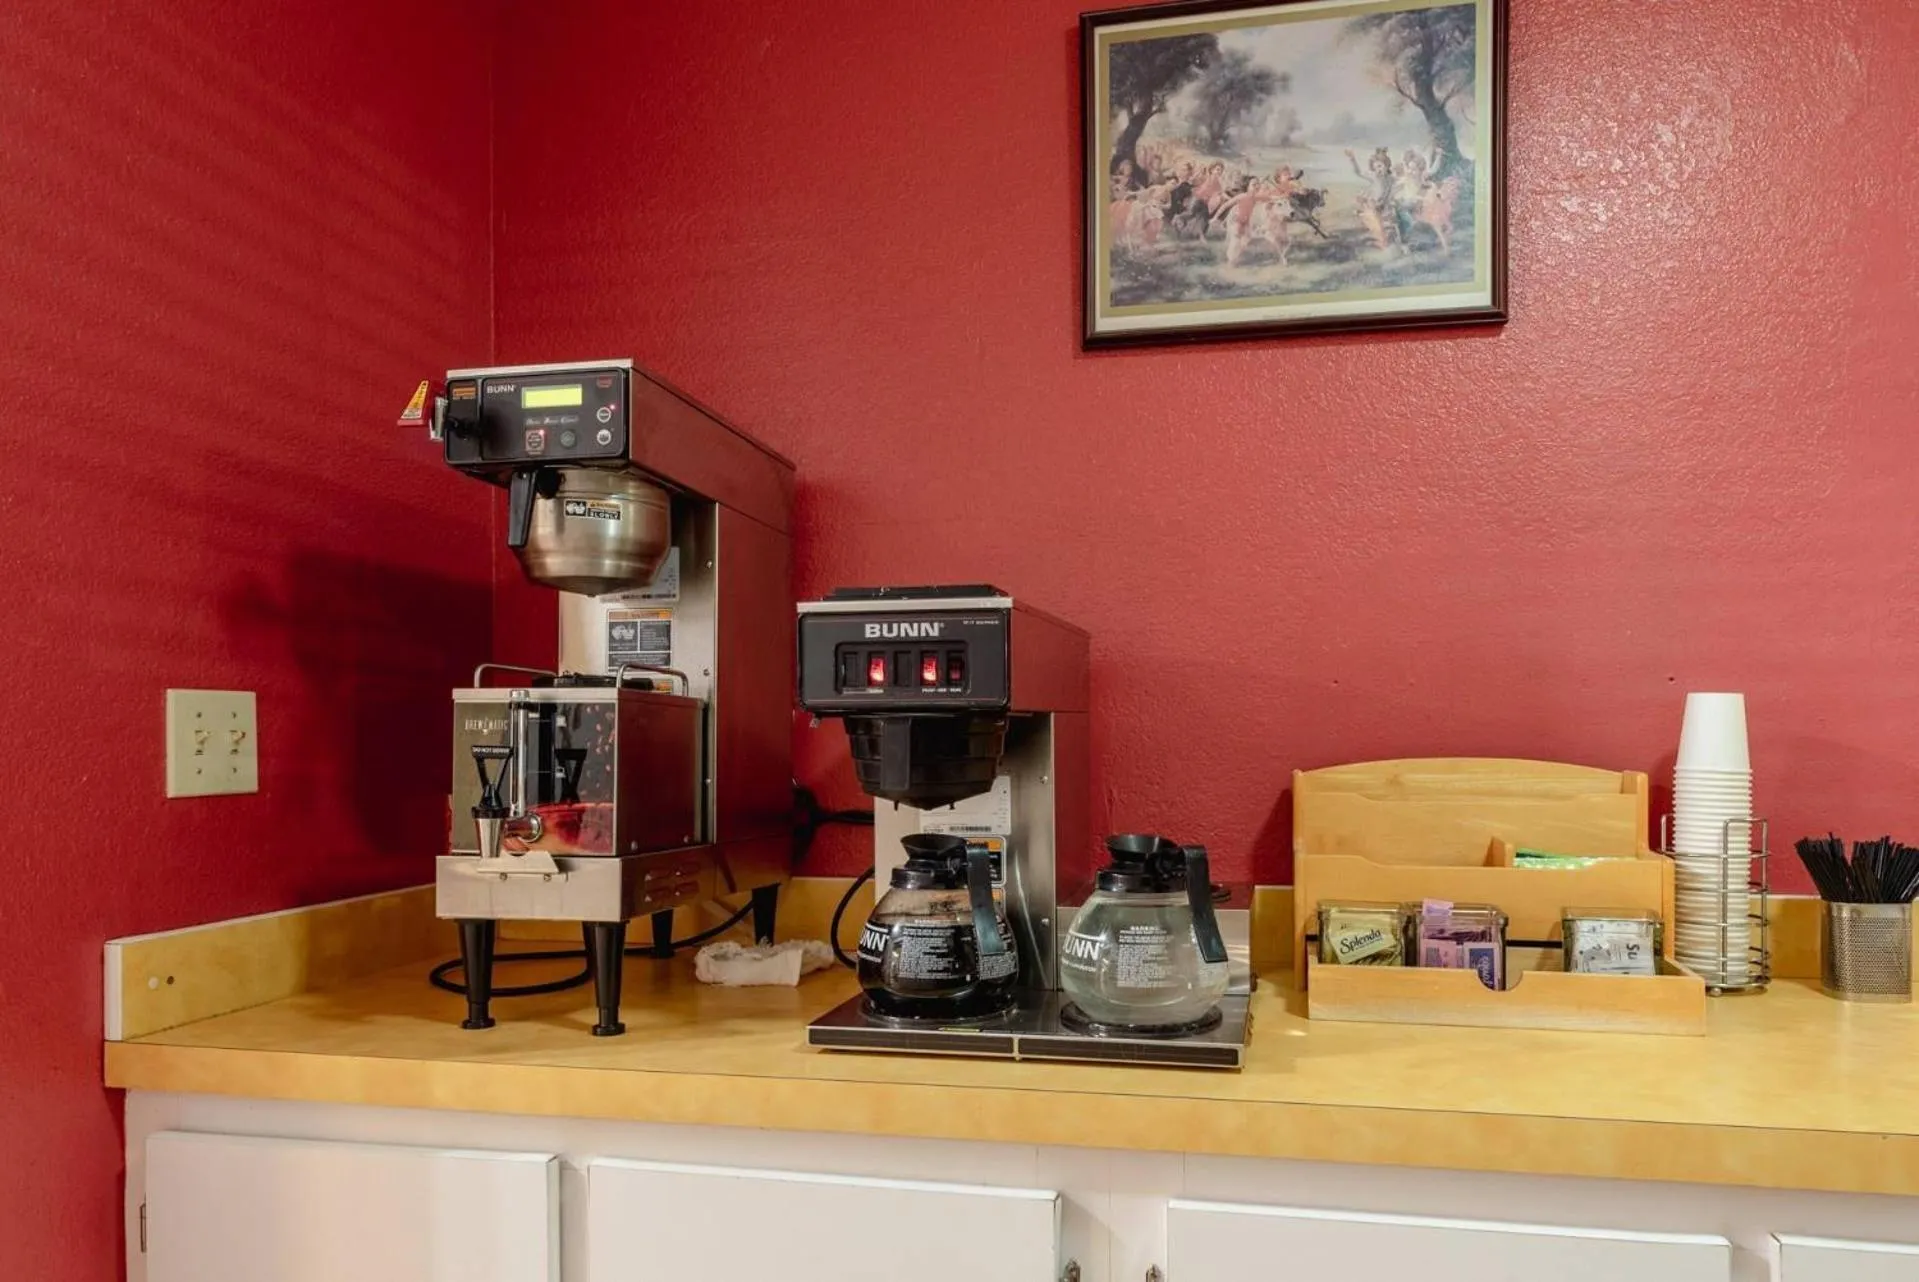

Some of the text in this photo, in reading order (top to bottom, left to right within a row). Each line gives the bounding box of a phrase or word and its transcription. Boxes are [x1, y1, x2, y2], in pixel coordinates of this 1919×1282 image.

[486, 384, 515, 394] BUNN
[864, 621, 940, 639] BUNN
[1062, 935, 1100, 961] UNN
[1339, 929, 1382, 955] Splenda
